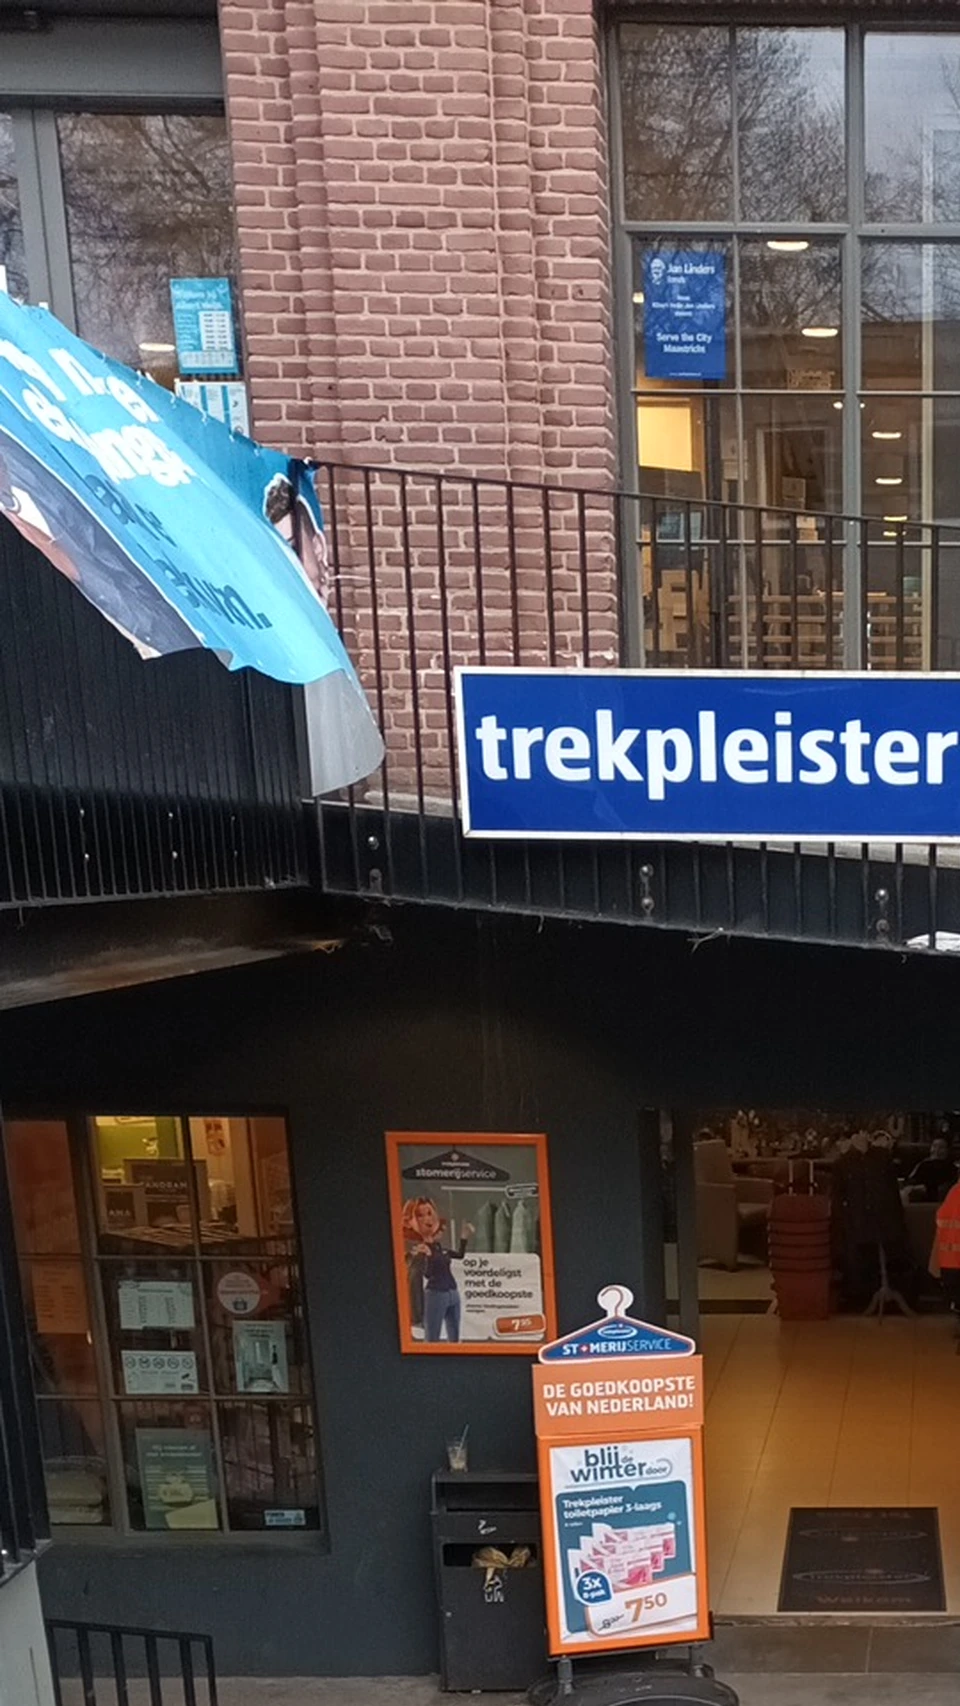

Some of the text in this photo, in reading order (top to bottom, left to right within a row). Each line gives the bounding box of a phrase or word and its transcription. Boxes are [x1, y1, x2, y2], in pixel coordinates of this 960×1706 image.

[656, 332, 712, 344] Serve the City
[476, 709, 958, 800] trekpleister
[463, 1267, 522, 1278] voordeligst
[464, 1279, 502, 1287] met de
[464, 1289, 534, 1300] goedkoopste
[543, 1376, 695, 1398] DE GOEDKOOPSTE
[546, 1393, 694, 1416] VAN NEDERLAND!
[584, 1446, 620, 1468] blij
[570, 1462, 646, 1482] winter
[562, 1495, 624, 1508] Trekpleister
[563, 1501, 662, 1519] toiletpapier 3-laags
[582, 1577, 602, 1590] 3x
